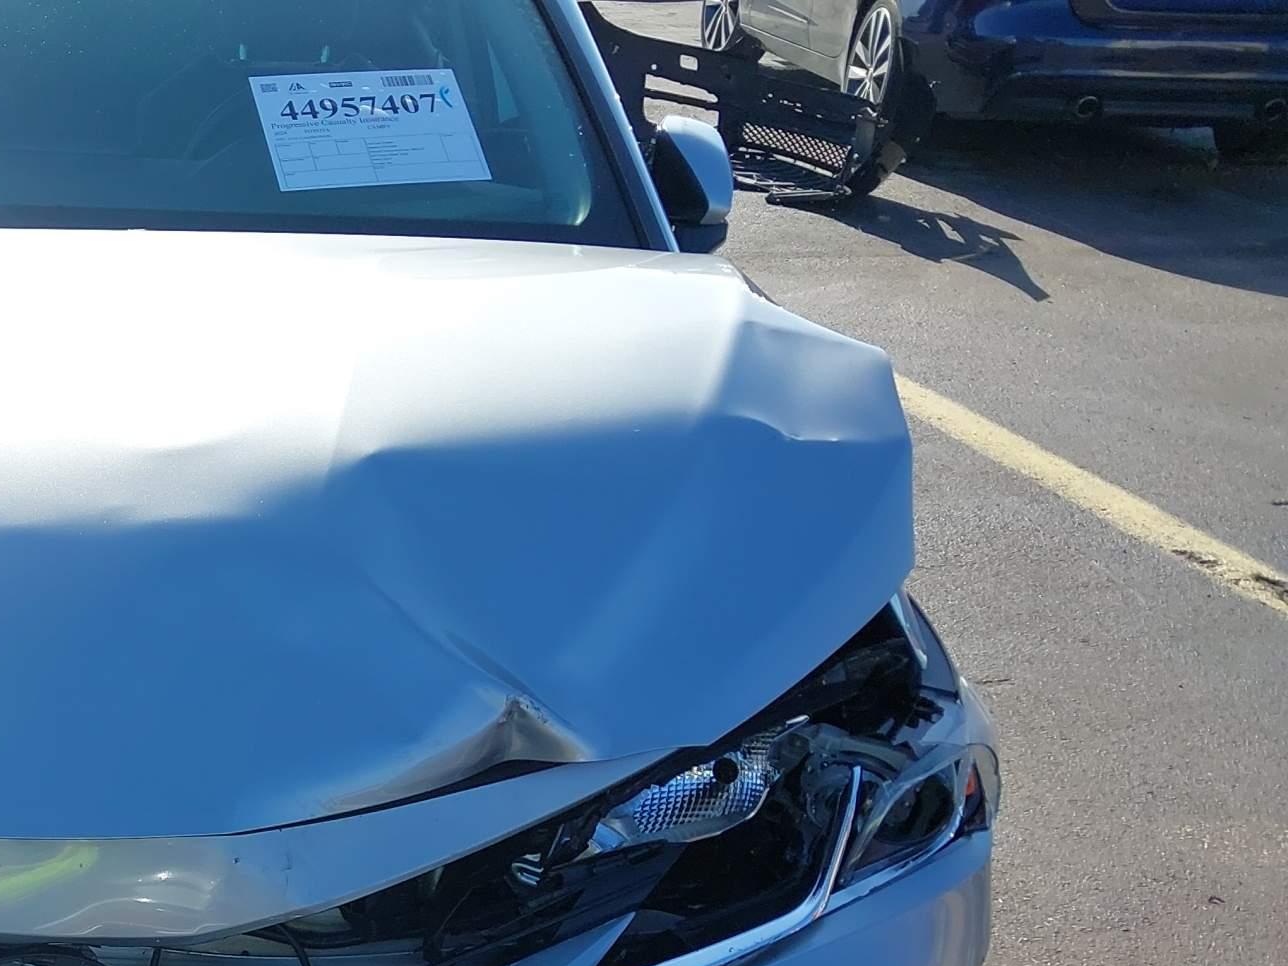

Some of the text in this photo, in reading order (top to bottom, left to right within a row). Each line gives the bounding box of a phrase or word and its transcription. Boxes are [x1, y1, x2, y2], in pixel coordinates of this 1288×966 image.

[281, 94, 436, 121] 44957407
[271, 116, 400, 130] Progressive Casualty Insurance
